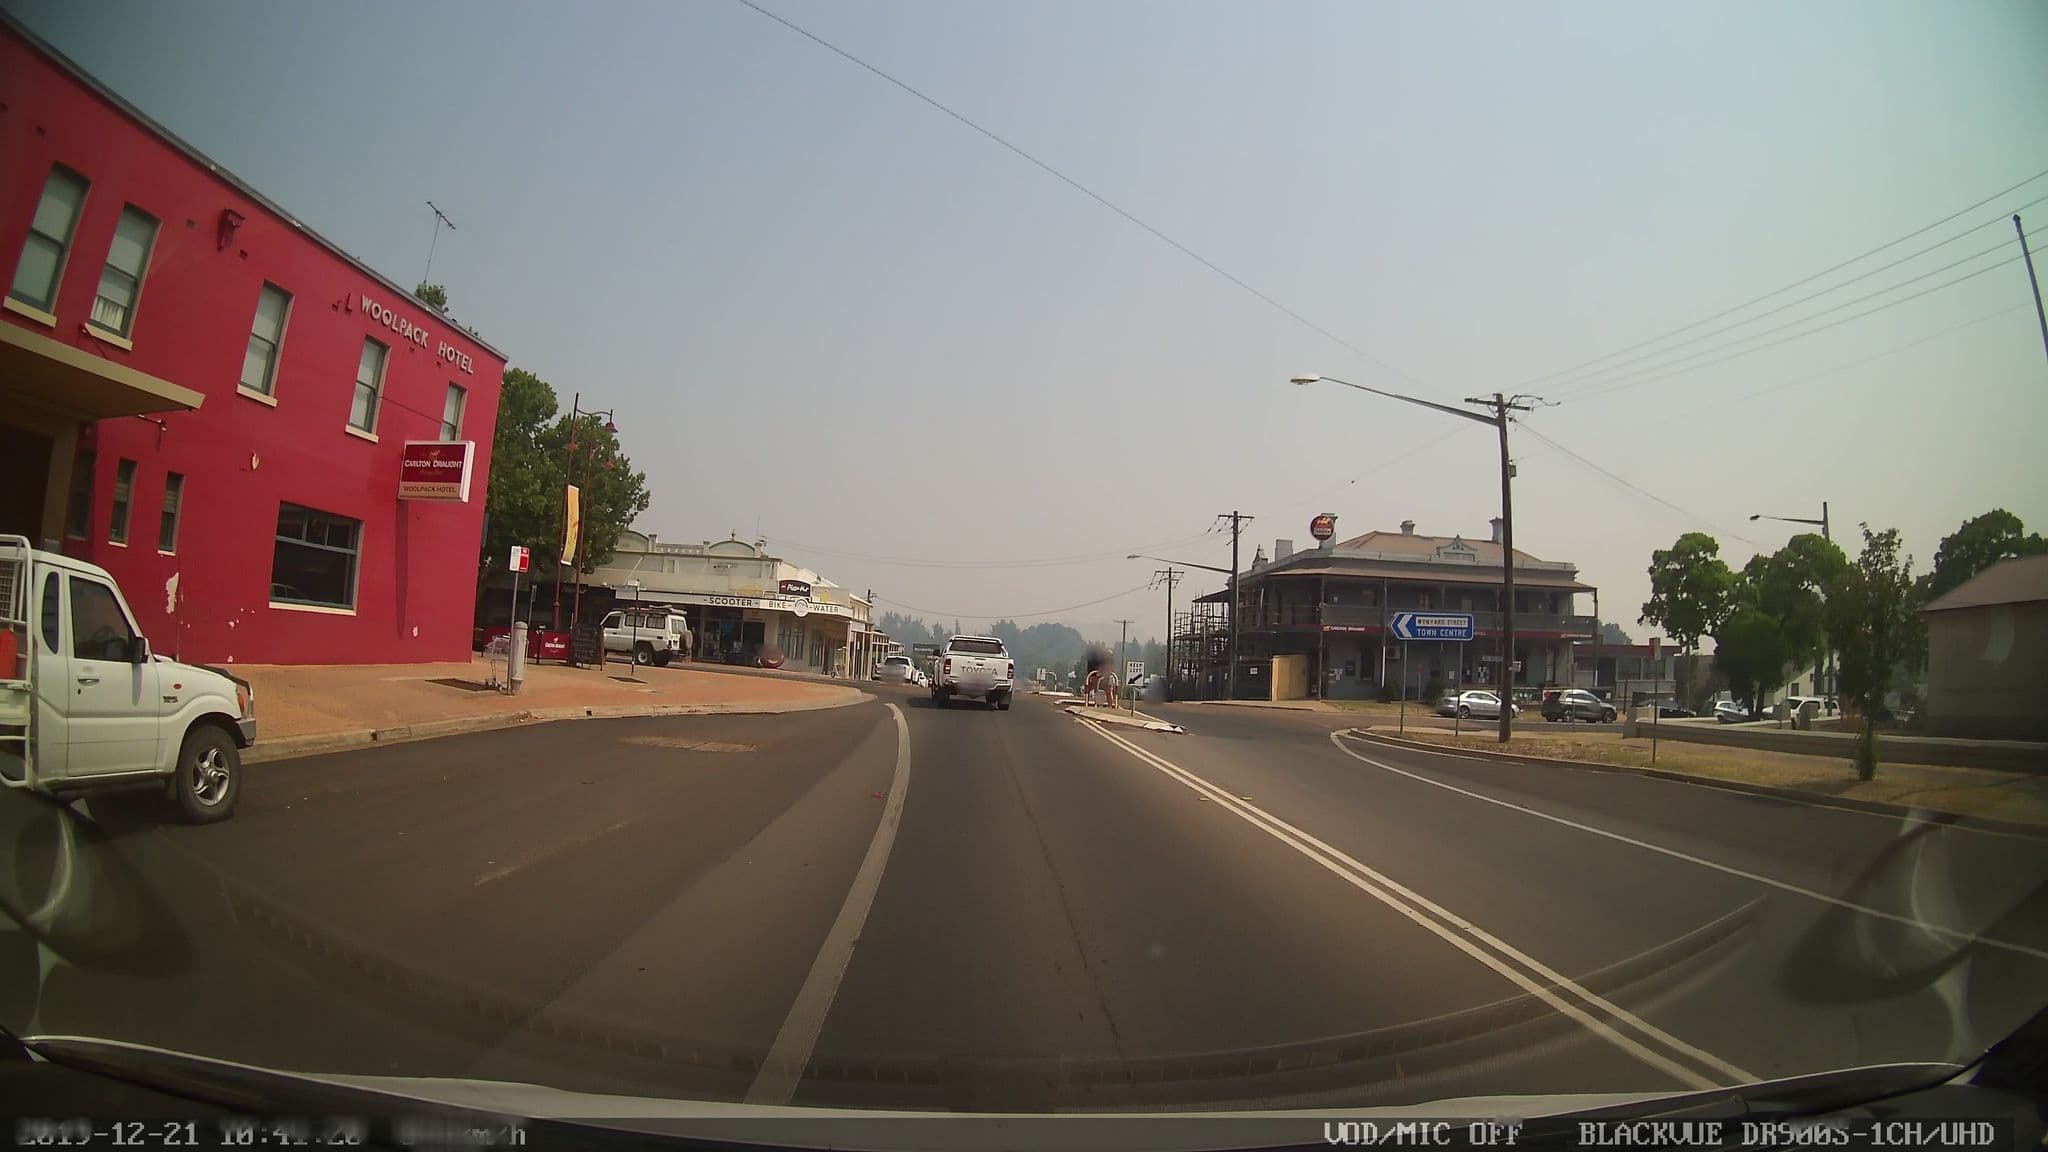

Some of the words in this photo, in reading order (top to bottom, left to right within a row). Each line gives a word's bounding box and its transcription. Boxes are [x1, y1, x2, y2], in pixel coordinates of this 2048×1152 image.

[361, 294, 429, 348] WOOLPACK
[437, 341, 474, 374] HOTEL
[404, 460, 431, 468] CARLTON
[709, 597, 753, 607] SCOOTER
[768, 600, 786, 609] BIKE
[813, 604, 839, 613] WATER
[1417, 628, 1437, 637] TOWN
[1439, 628, 1467, 637] CENTRE
